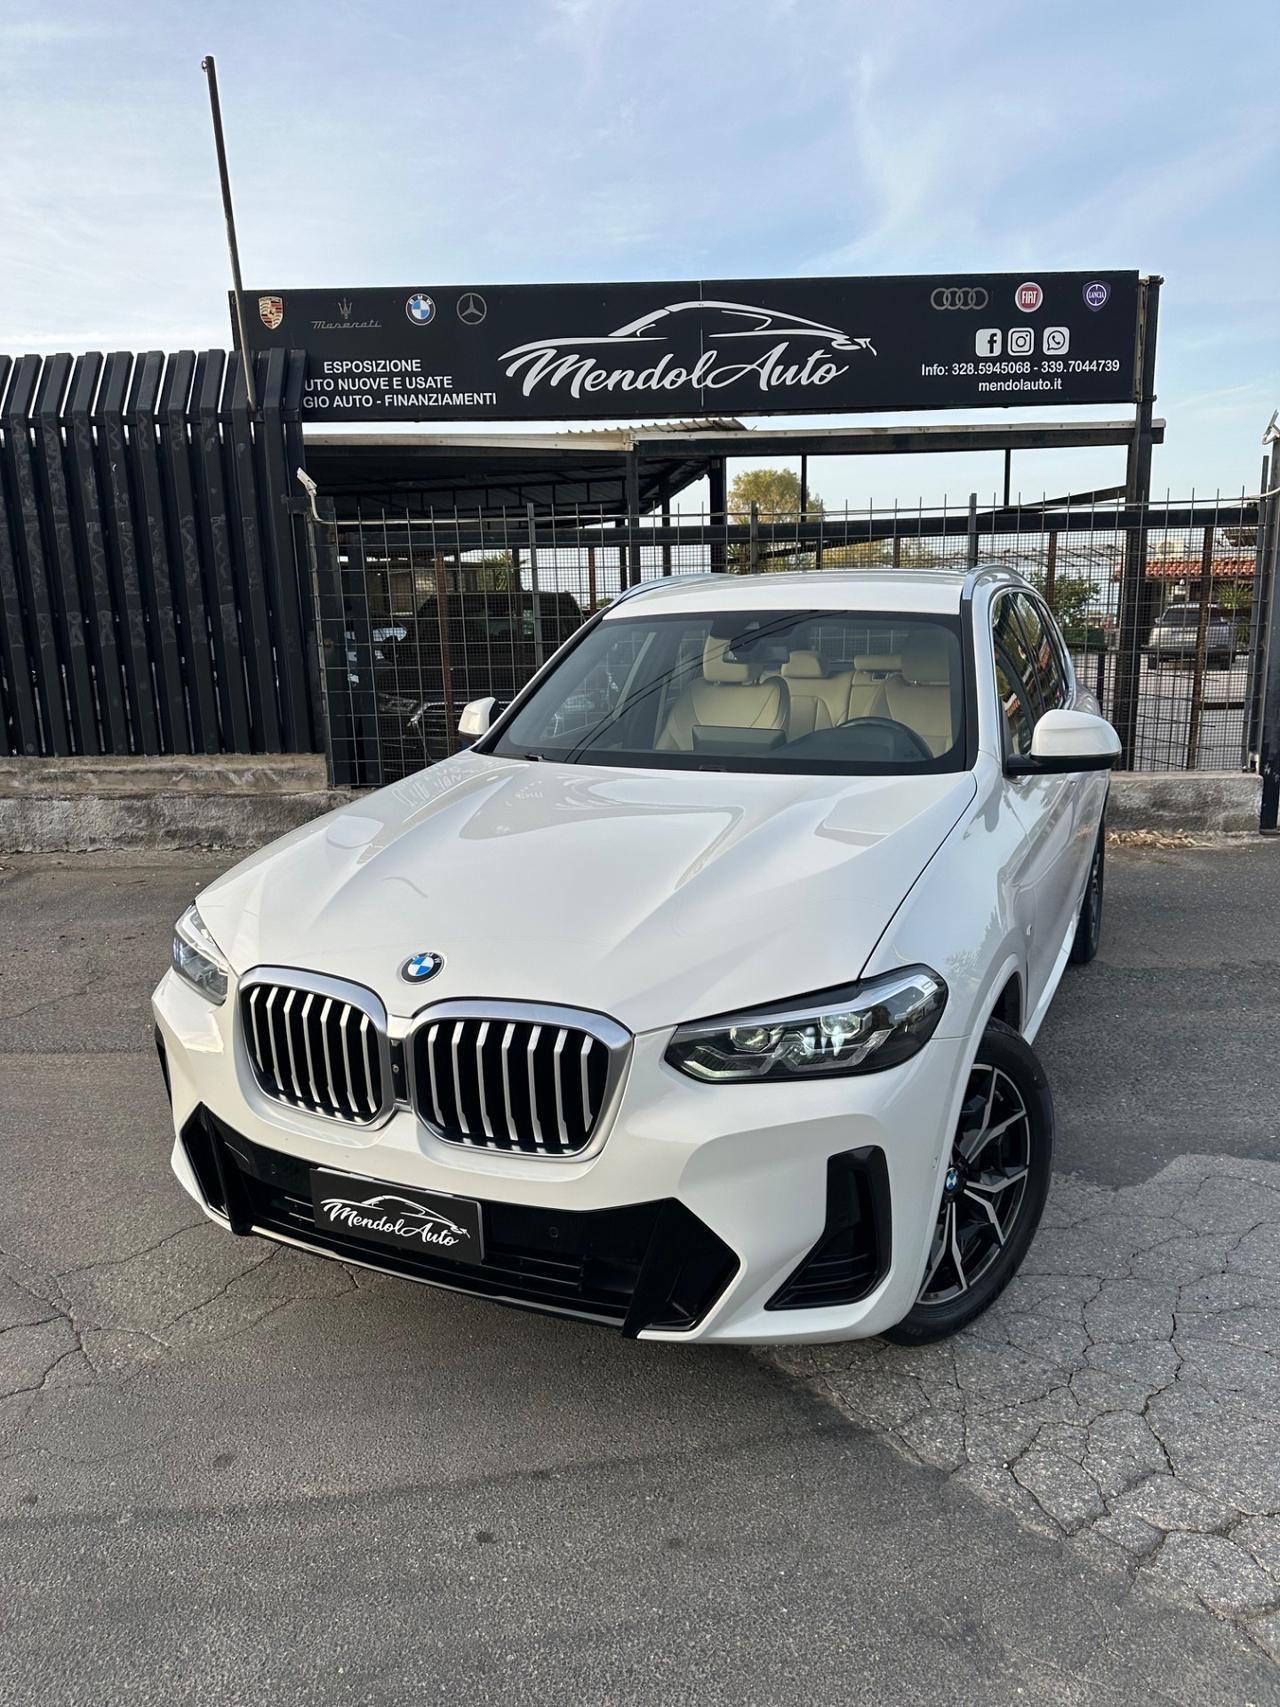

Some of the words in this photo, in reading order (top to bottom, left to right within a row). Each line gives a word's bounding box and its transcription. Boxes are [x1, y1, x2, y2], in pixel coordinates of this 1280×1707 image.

[1021, 291, 1038, 304] FIAT
[311, 320, 382, 329] Maserati
[323, 359, 422, 373] ESPOSIZIONE
[921, 364, 949, 376] Info:
[951, 362, 1031, 375] 328.5945068
[1041, 359, 1120, 373] 339.7044739
[304, 379, 334, 391] UTO
[338, 377, 389, 390] NUOVE
[393, 377, 402, 389] E
[405, 376, 453, 389] USATE
[978, 378, 1062, 391] mendolauto.it
[333, 394, 373, 407] AUTO
[384, 392, 497, 406] FINANZIAMENTI
